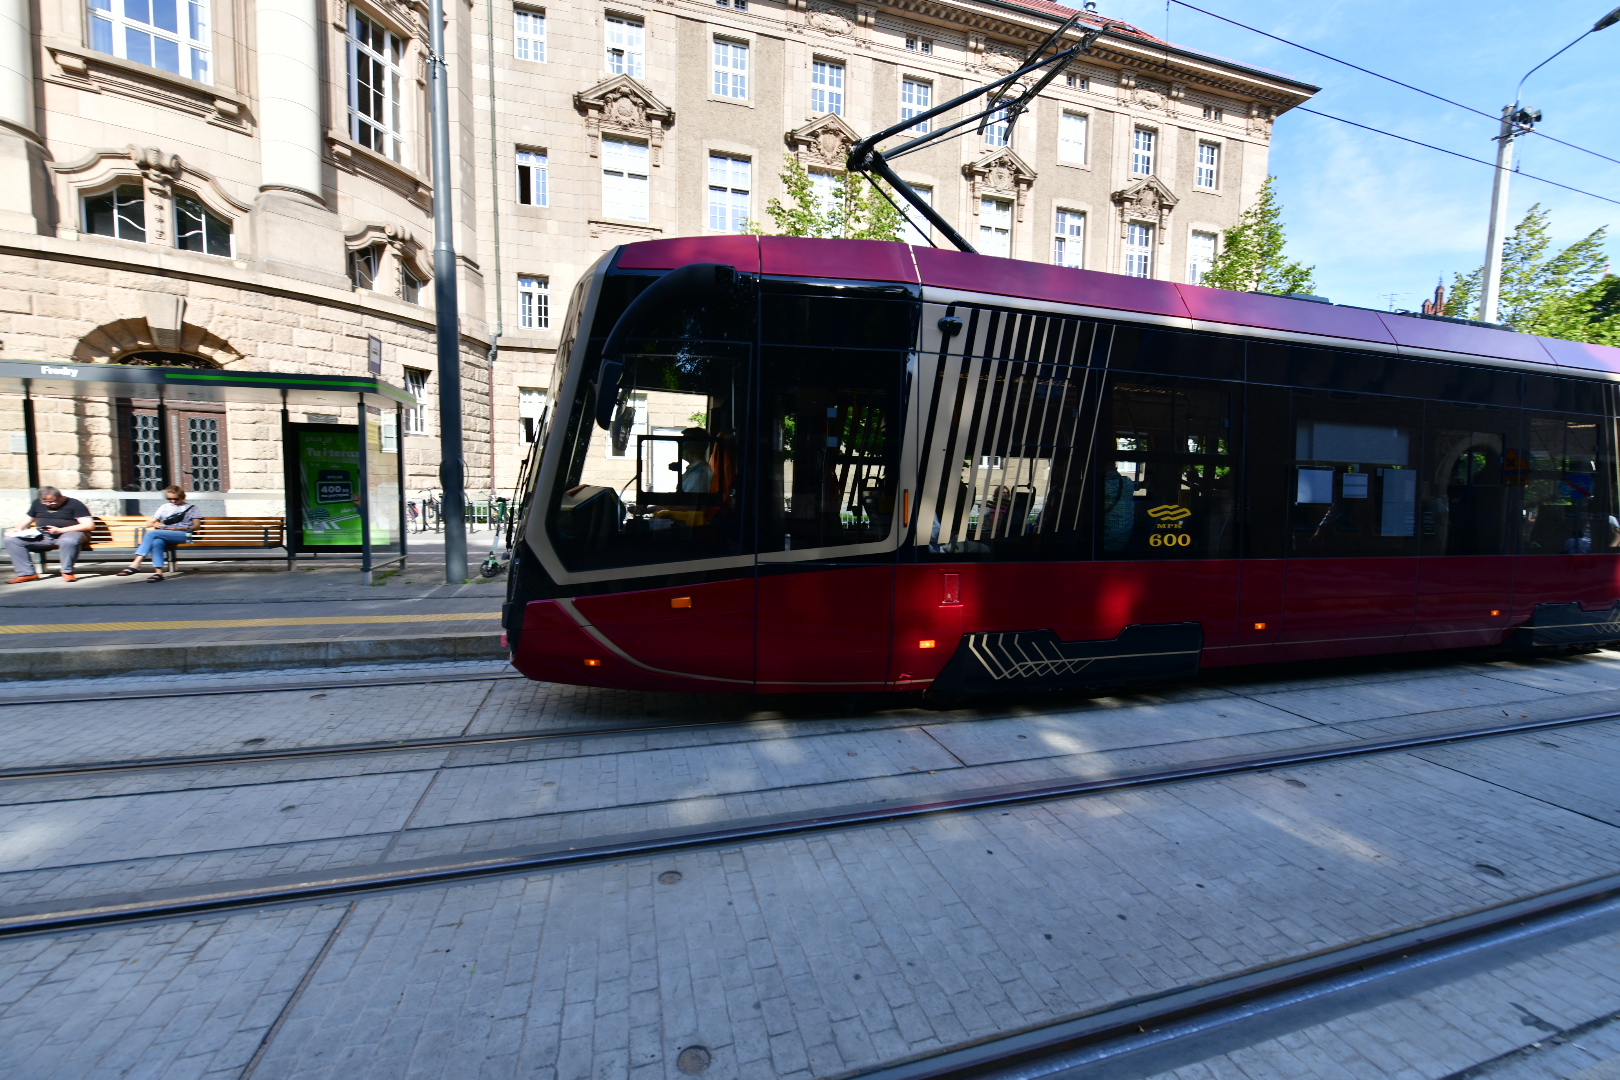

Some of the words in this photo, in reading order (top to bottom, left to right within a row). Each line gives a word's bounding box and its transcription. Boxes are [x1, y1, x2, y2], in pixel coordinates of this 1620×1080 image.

[306, 447, 321, 456] Tu
[324, 447, 327, 456] i
[330, 449, 359, 458] teraz
[1149, 533, 1191, 547] 600
